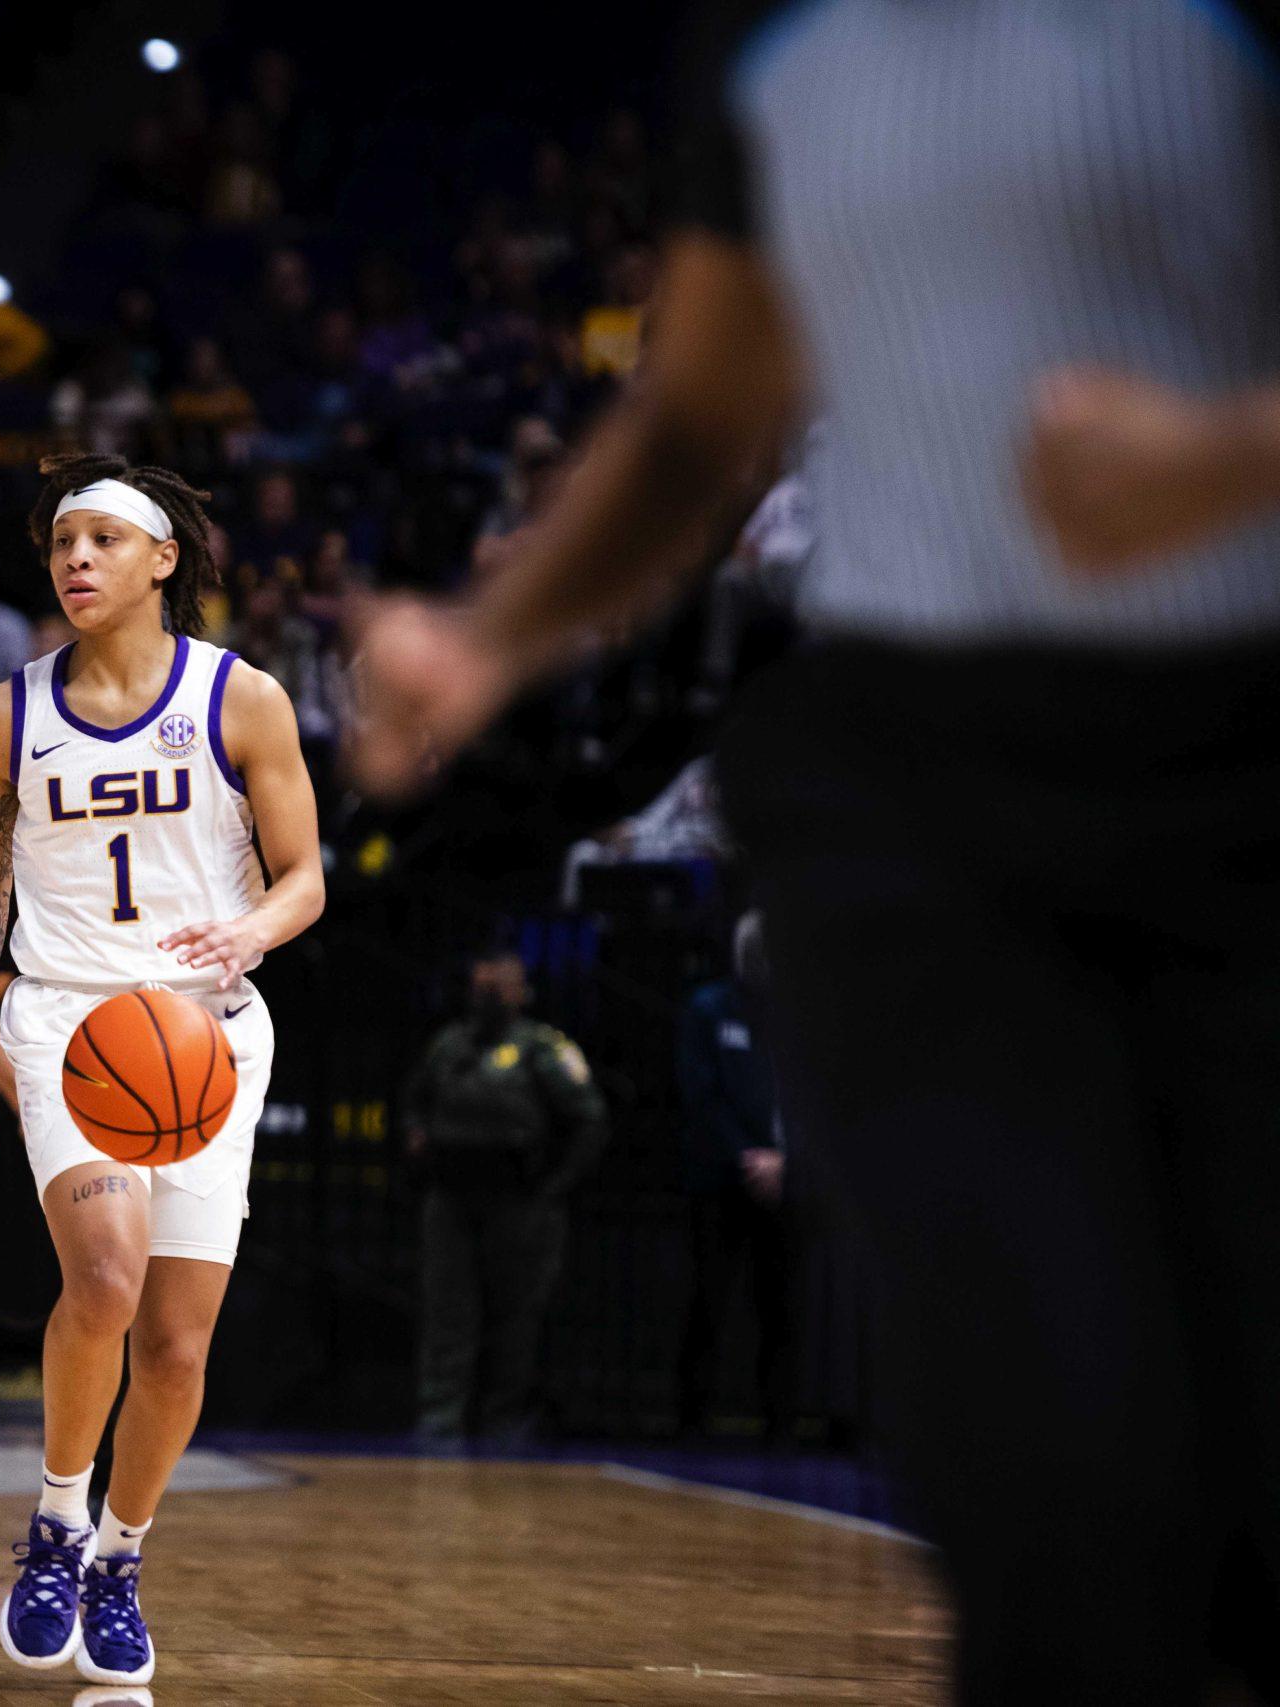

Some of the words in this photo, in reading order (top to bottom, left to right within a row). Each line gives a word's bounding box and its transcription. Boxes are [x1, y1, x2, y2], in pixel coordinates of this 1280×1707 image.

[161, 715, 195, 747] SEC
[46, 767, 192, 824] LSU
[107, 832, 140, 923] 1
